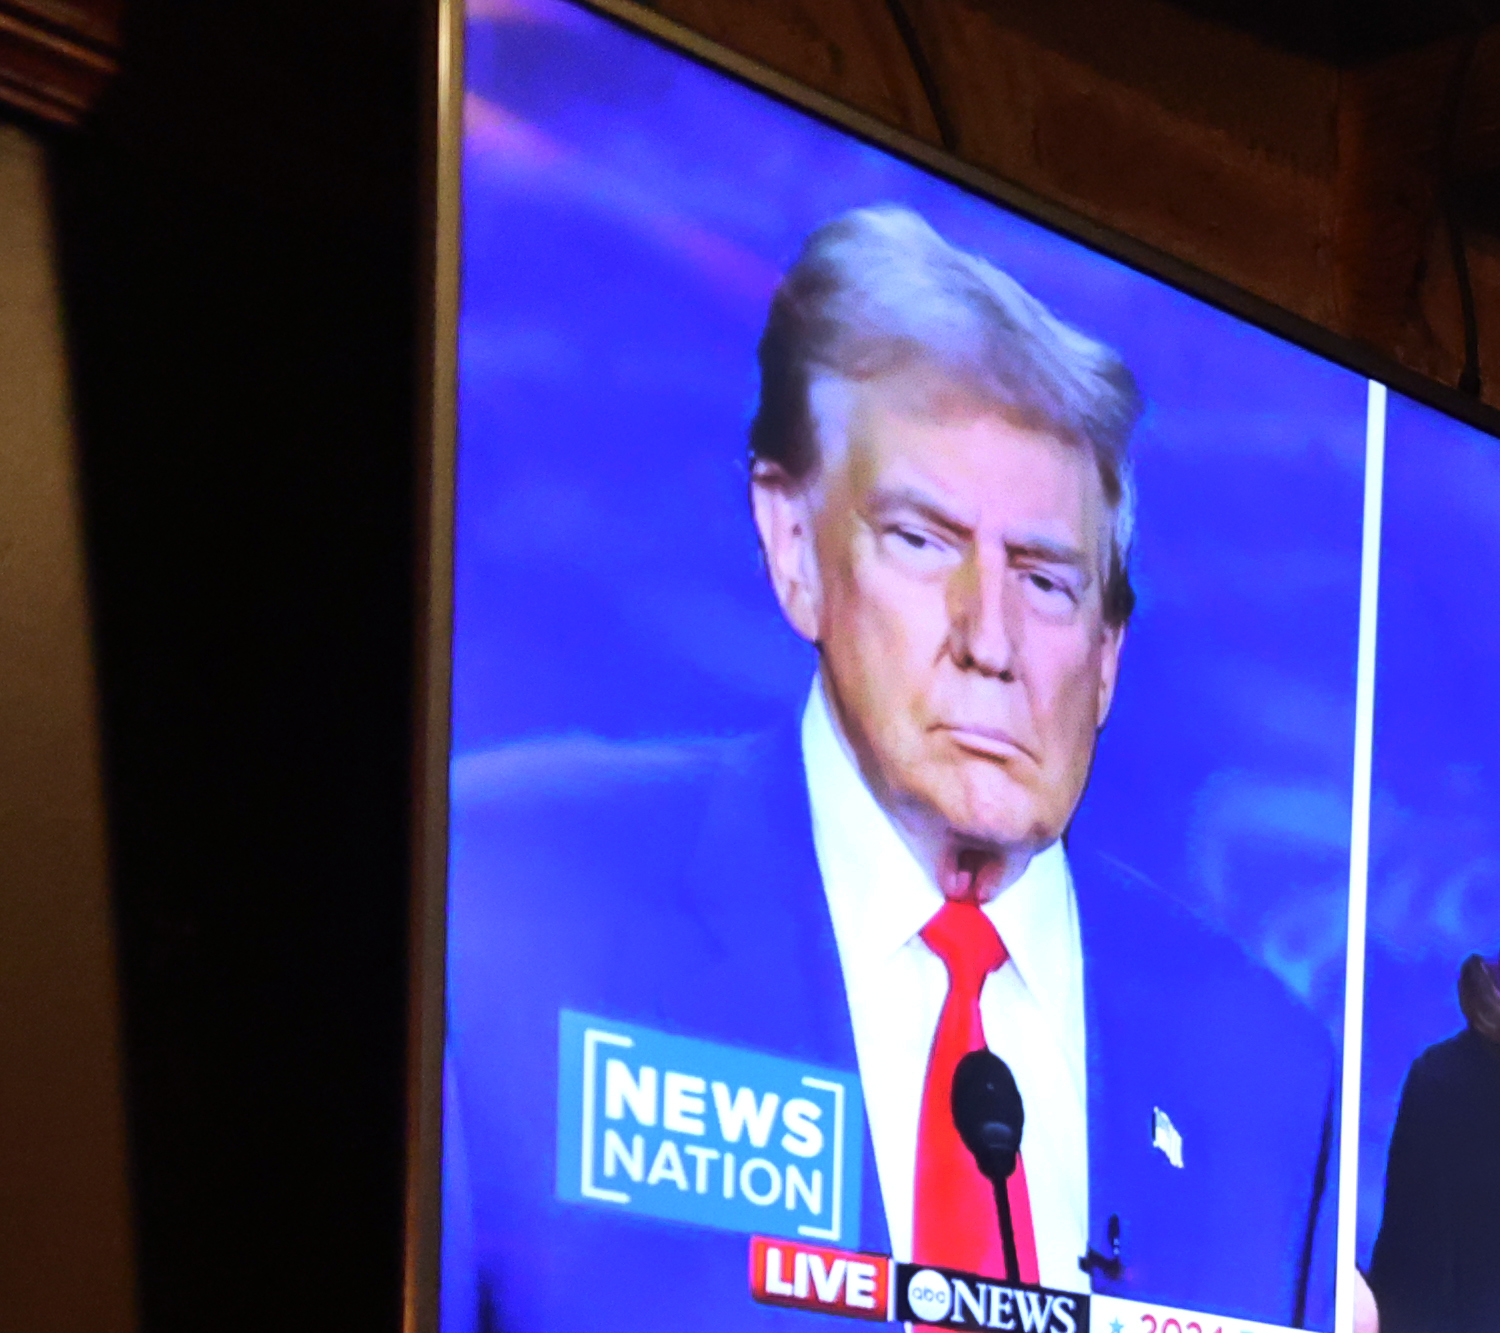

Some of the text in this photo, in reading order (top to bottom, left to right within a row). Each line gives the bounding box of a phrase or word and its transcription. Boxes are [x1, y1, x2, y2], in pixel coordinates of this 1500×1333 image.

[605, 1058, 824, 1158] NEWS
[603, 1128, 822, 1215] NATION
[765, 1247, 877, 1309] LIVE
